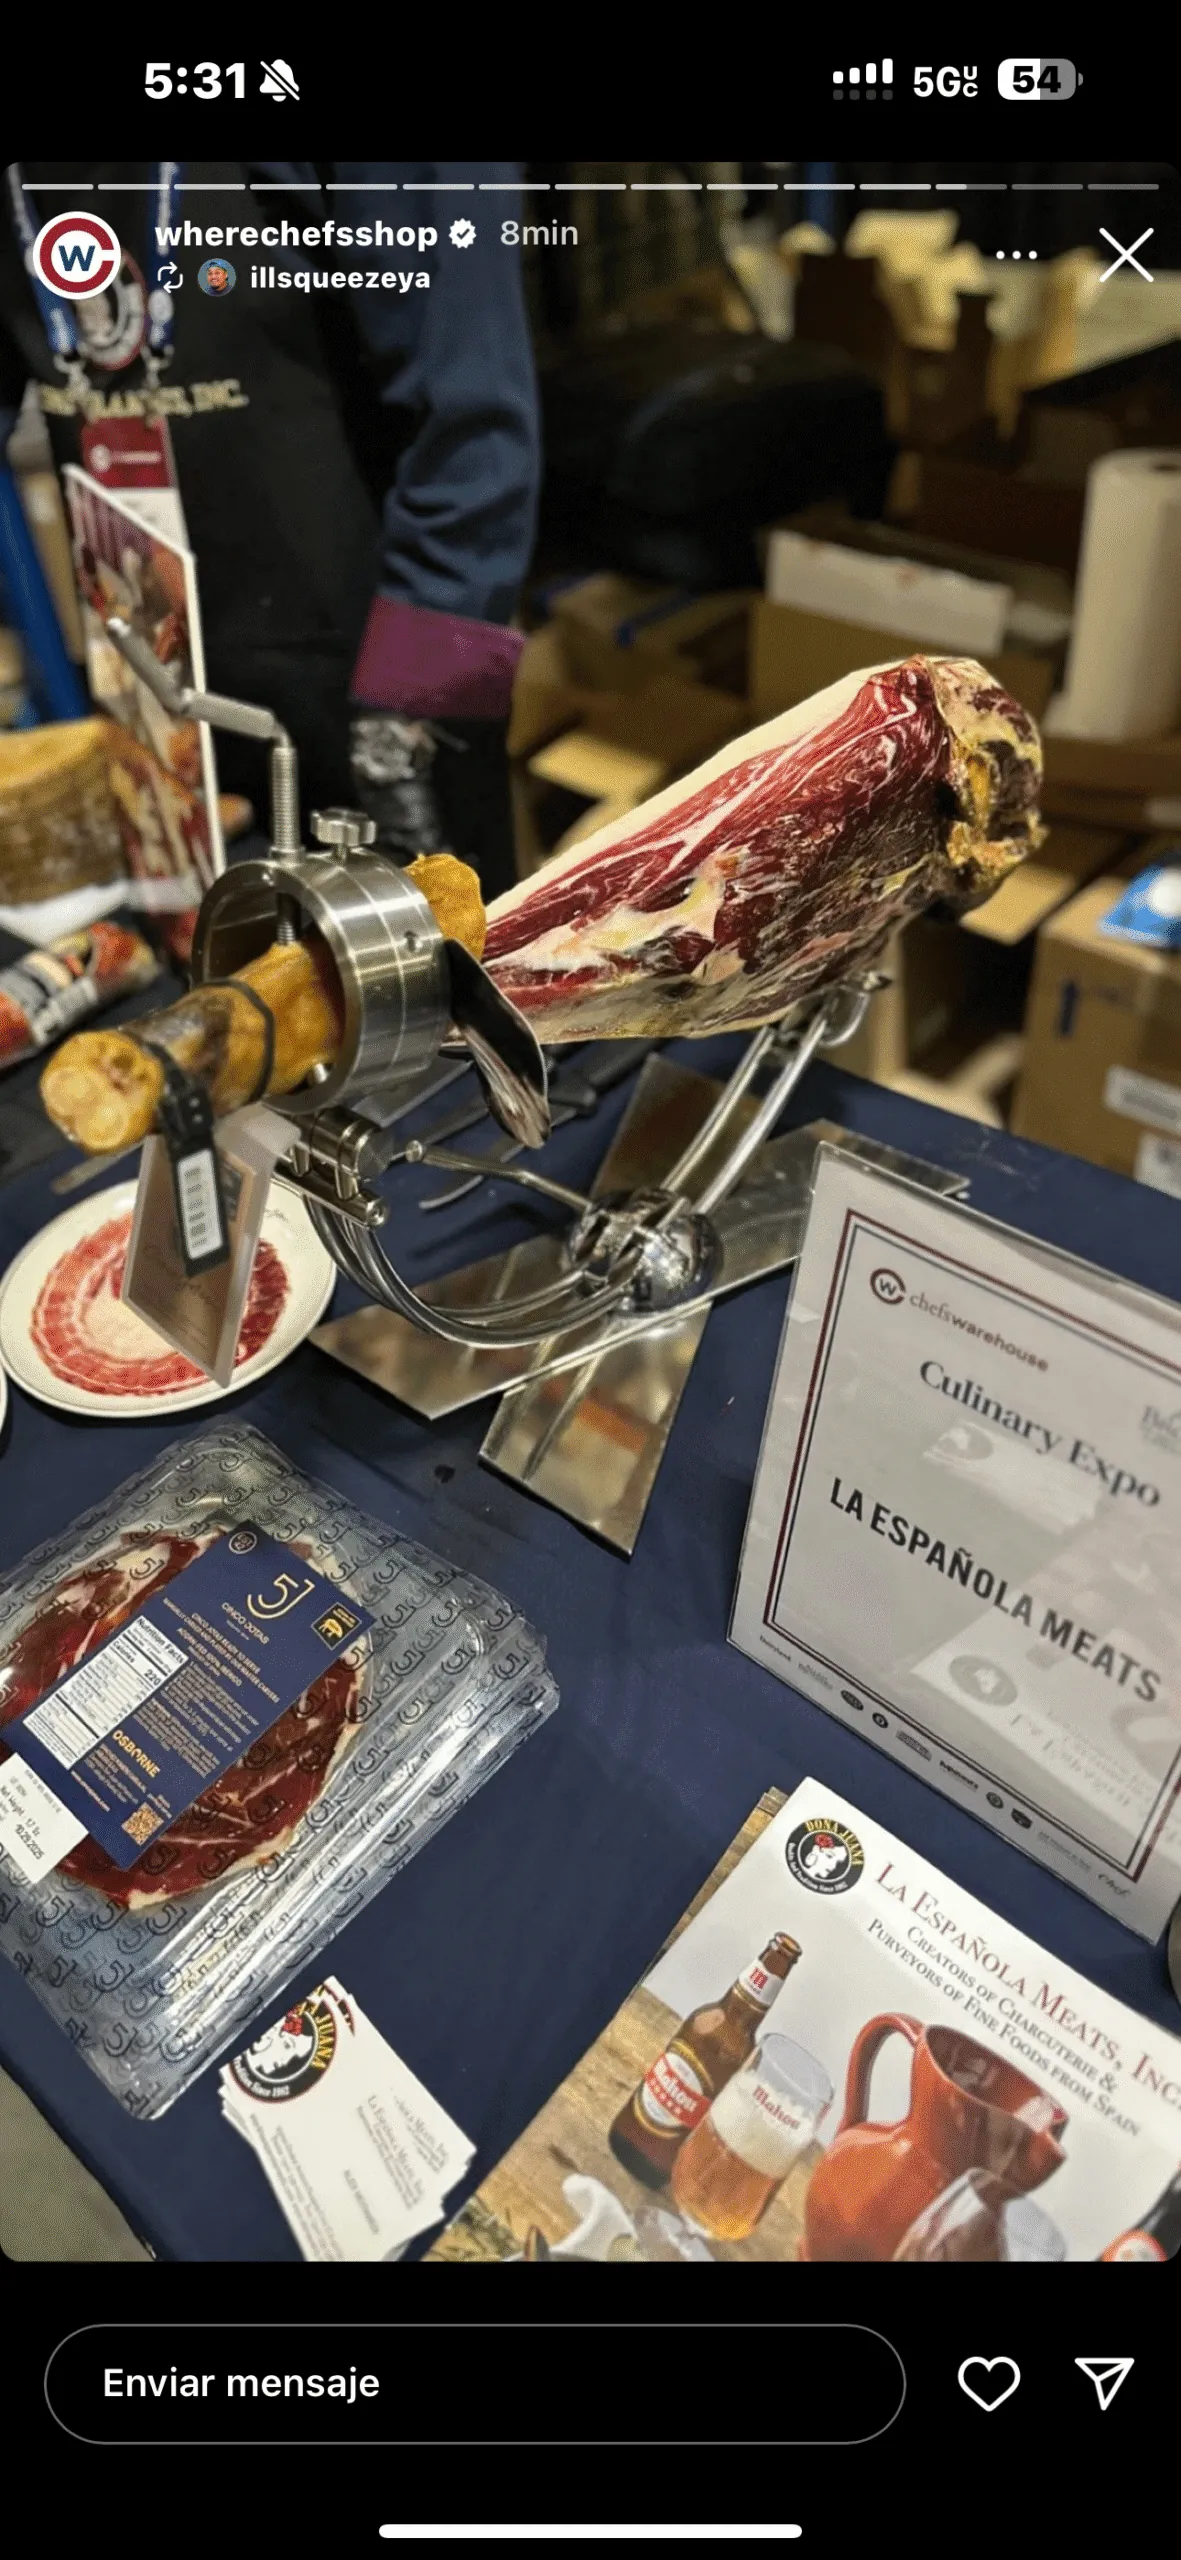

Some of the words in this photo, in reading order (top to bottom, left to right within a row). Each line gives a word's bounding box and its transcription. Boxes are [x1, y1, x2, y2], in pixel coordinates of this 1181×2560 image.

[909, 1291, 1049, 1372] chefswarehouse
[919, 1360, 1062, 1455] Culinary
[1068, 1439, 1161, 1507] Expo
[247, 1573, 316, 1619] 5J
[830, 1477, 863, 1521] LA
[870, 1502, 1033, 1628] ESPAÑOLA
[1040, 1608, 1162, 1703] MEATS
[135, 1617, 167, 1646] Nutrition
[163, 1643, 185, 1663] Facts
[143, 1668, 162, 1685] 220
[112, 1729, 160, 1777] OSBORNE
[876, 1862, 907, 1903] LA
[911, 1891, 1027, 1998] ESPAÑOLA
[1029, 1979, 1123, 2072] MEATS,
[311, 2013, 335, 2070] JUANA
[867, 1917, 944, 1989] PURVEYORS
[943, 1983, 965, 2002] OF
[963, 1994, 1001, 2031] FINE
[999, 2022, 1050, 2072] FOODS
[1050, 2064, 1094, 2104] FROM
[1092, 2093, 1141, 2137] SPAIN
[907, 1926, 977, 1988] CREATORS
[976, 1983, 998, 2003] OF
[1098, 2072, 1117, 2094] &
